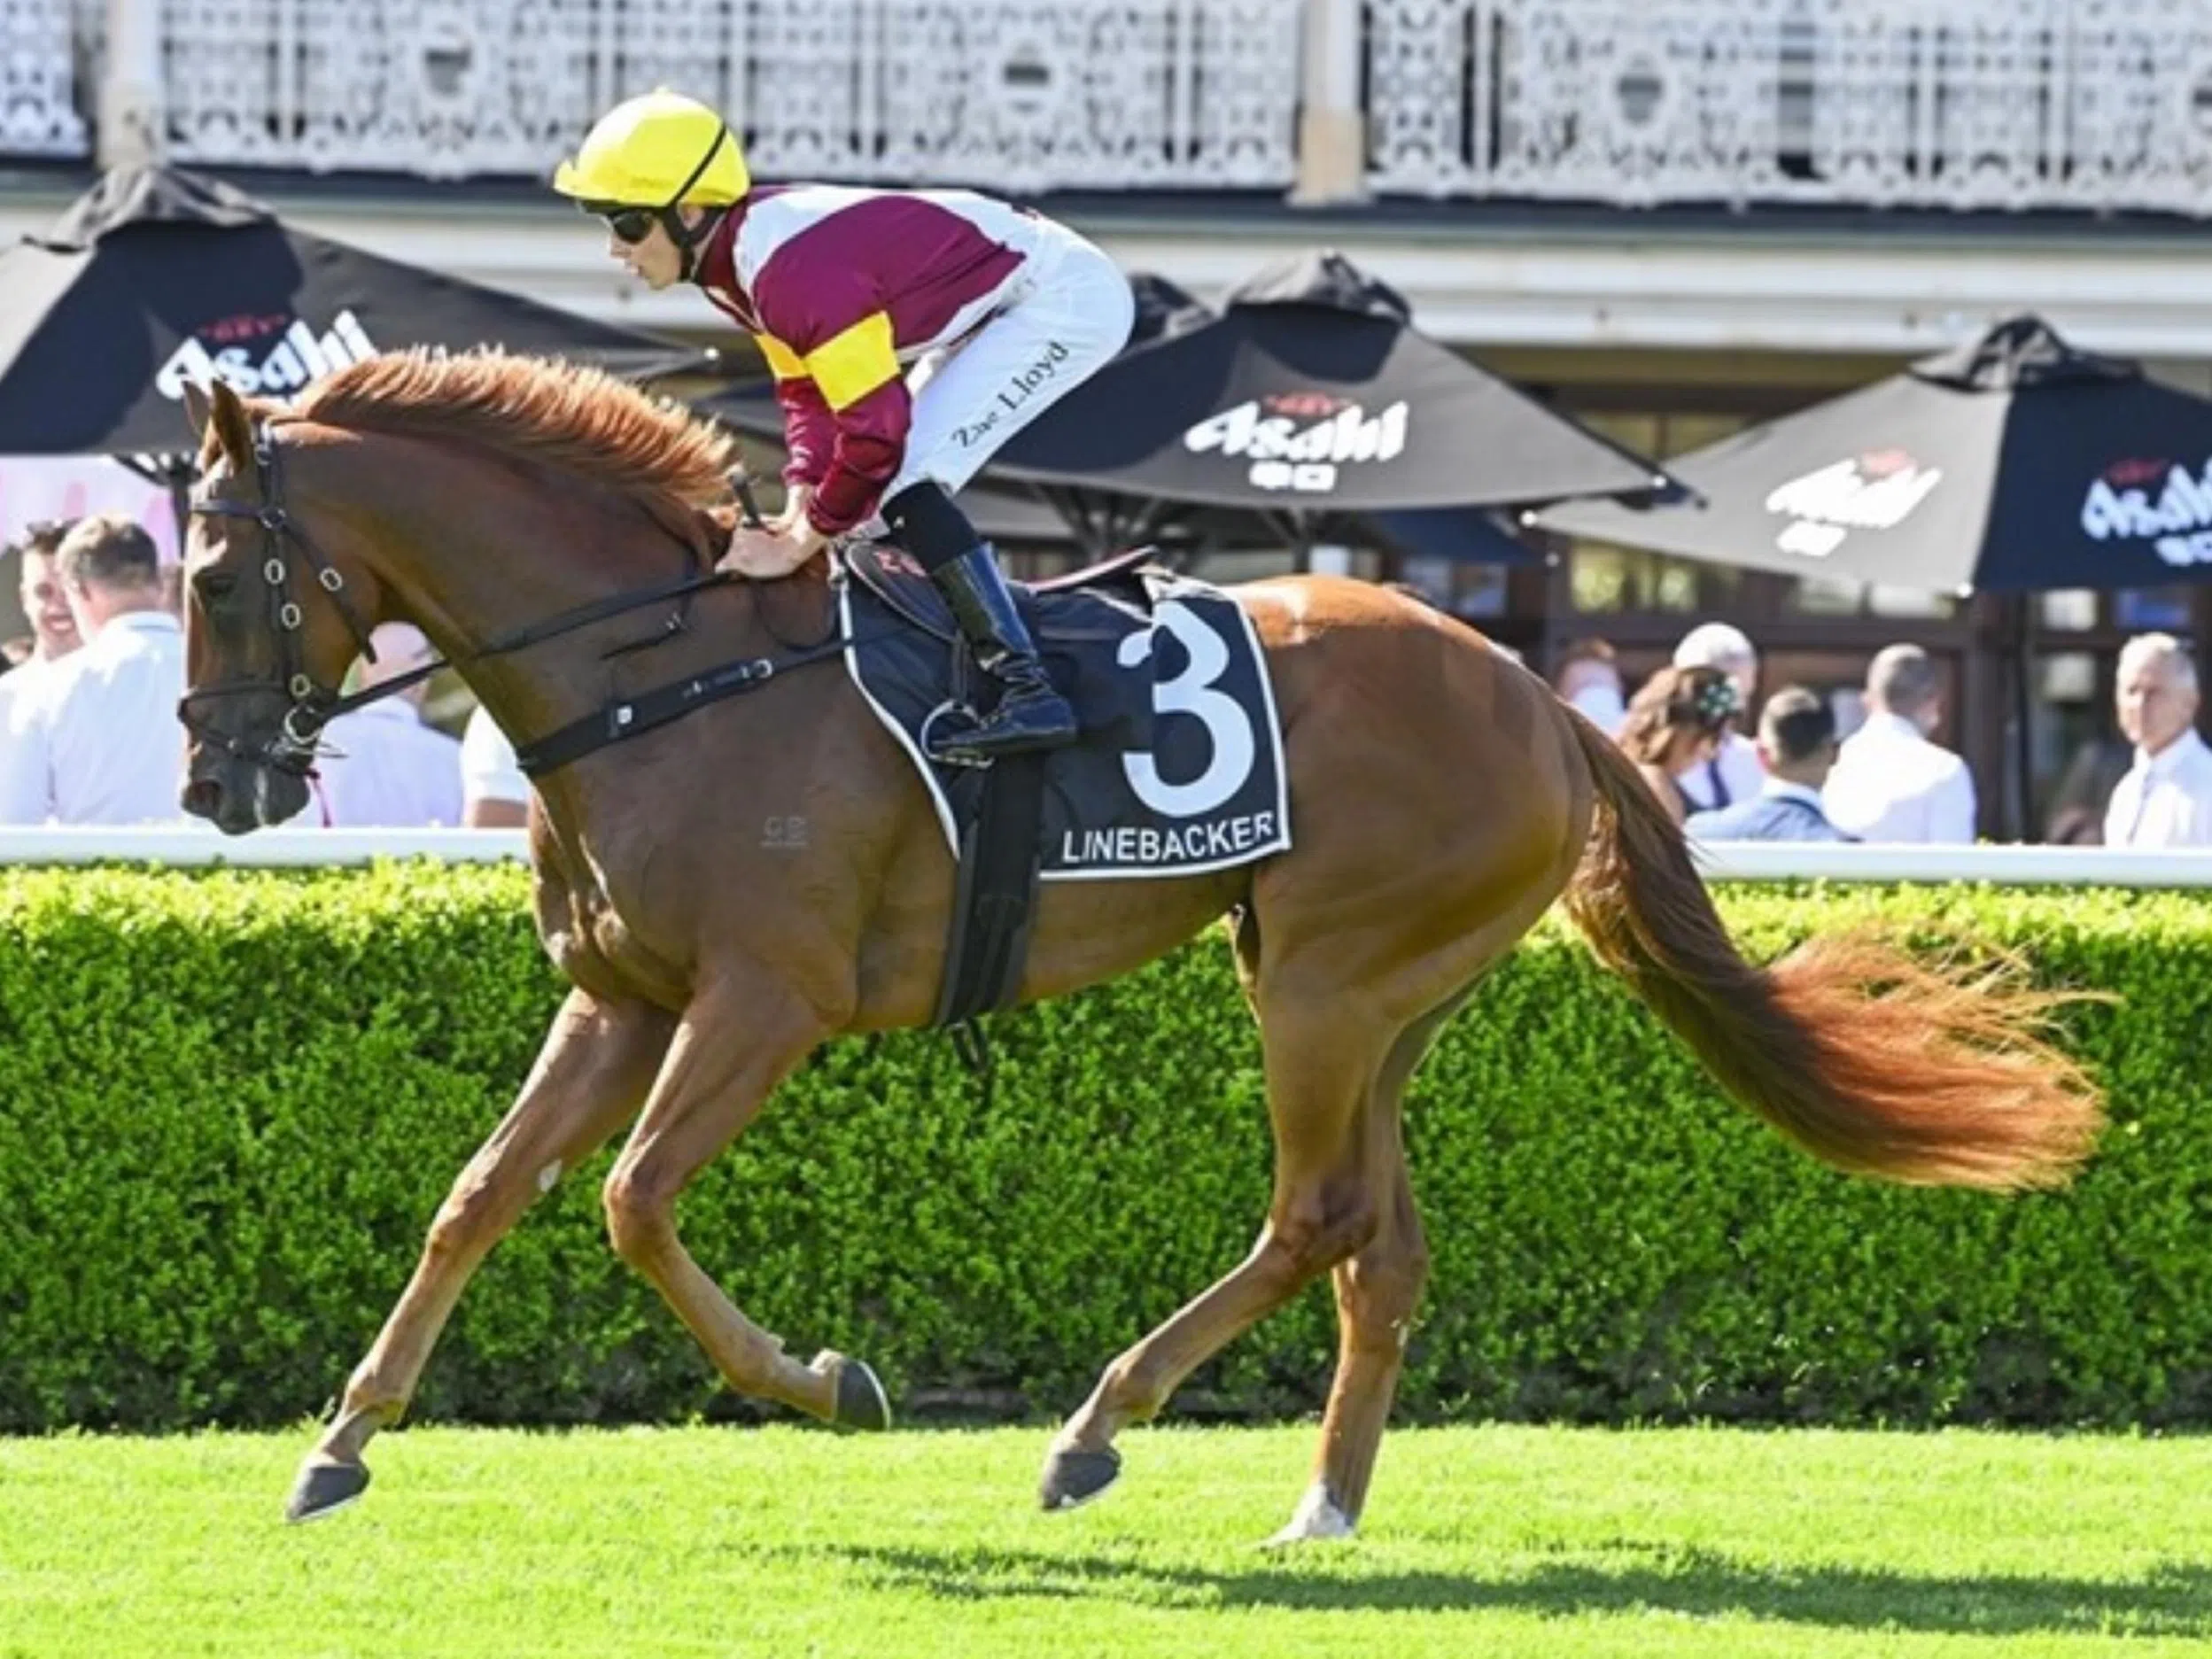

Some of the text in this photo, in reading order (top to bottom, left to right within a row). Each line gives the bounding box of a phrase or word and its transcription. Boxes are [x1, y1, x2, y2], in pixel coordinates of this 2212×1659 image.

[155, 309, 382, 399] Asahi
[951, 340, 1068, 447] Zac Lloyd
[1184, 400, 1409, 462] Asahi
[1116, 600, 1255, 817] 3
[1063, 810, 1274, 864] LINEBACKER
